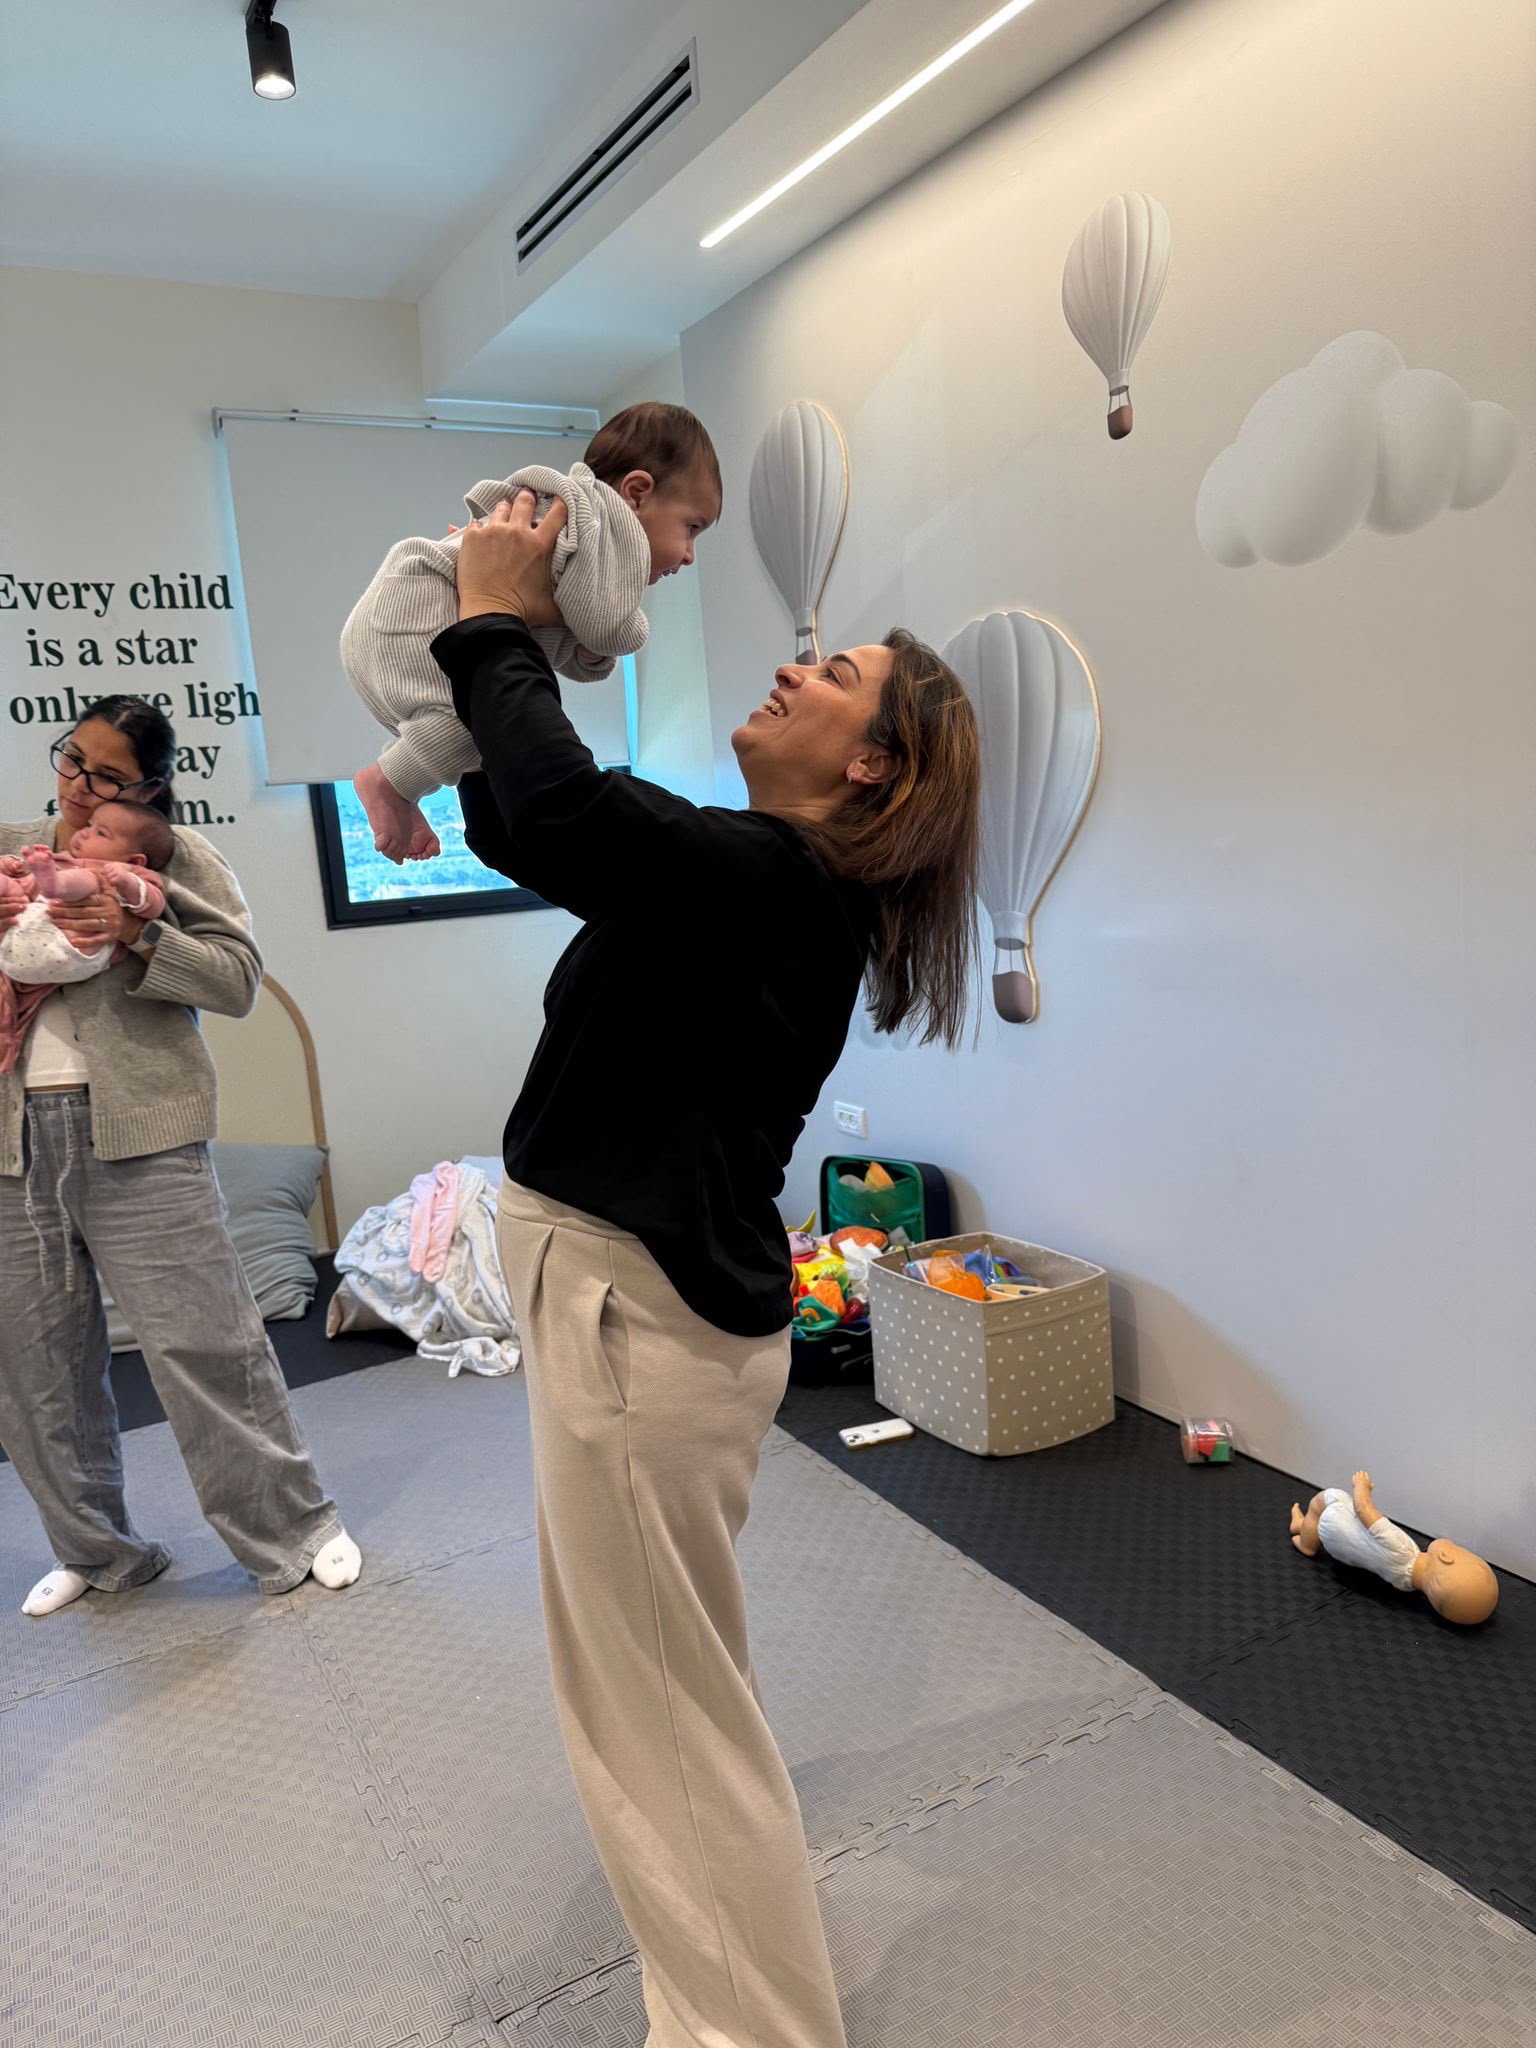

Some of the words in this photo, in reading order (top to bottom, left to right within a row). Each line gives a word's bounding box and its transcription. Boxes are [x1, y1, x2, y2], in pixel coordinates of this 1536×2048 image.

[0, 574, 115, 617] Every
[129, 572, 234, 610] child
[26, 628, 64, 667] is
[78, 638, 103, 666] a
[116, 629, 198, 666] star
[176, 744, 221, 779] ay
